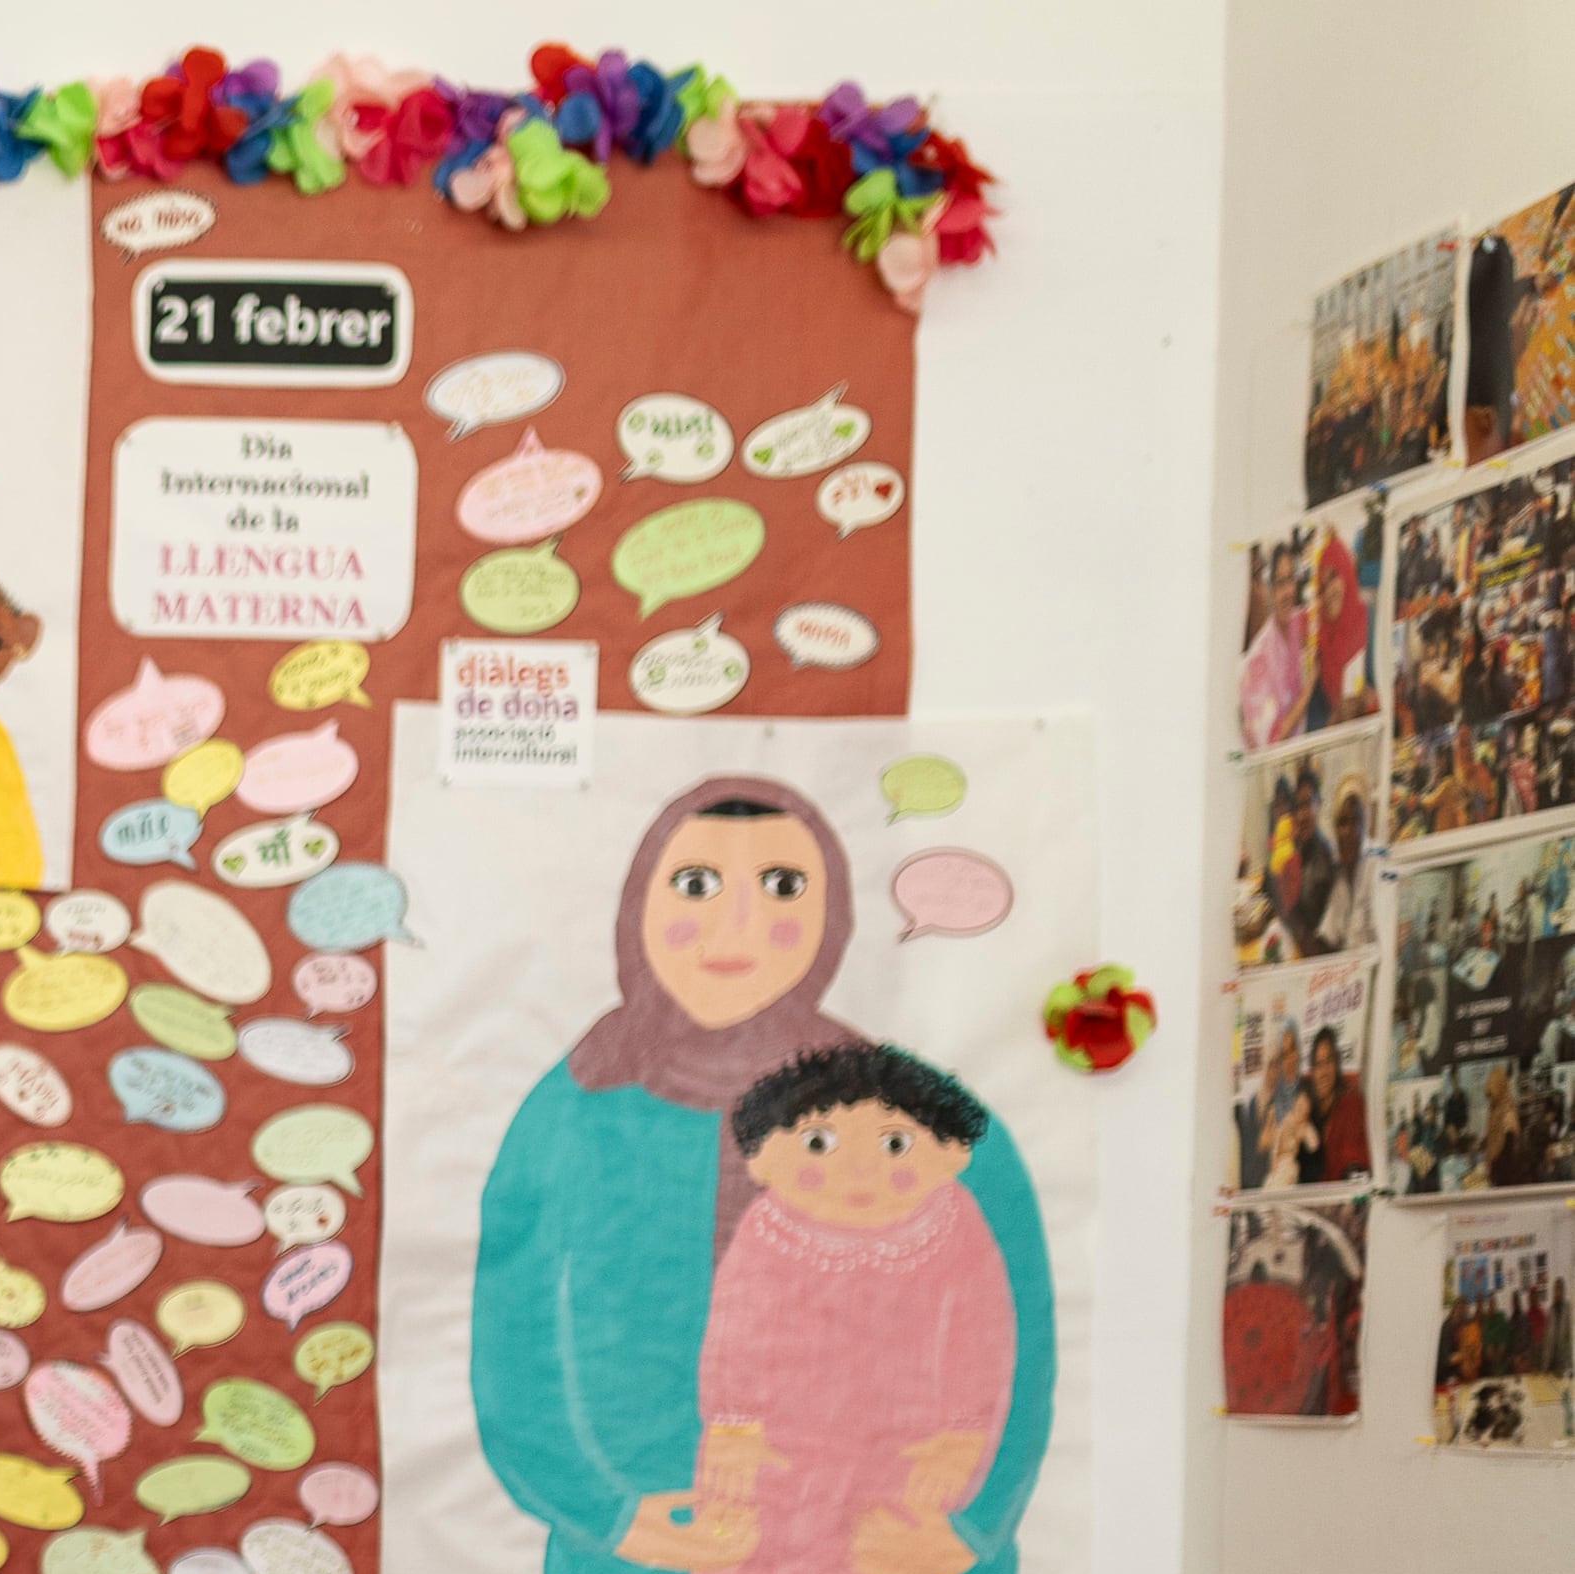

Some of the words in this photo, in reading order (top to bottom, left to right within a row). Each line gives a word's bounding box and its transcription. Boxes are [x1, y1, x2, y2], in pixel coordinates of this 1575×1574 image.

[155, 294, 215, 344] 21
[232, 294, 391, 347] febrer
[160, 469, 370, 499] Internacional
[227, 504, 263, 532] de
[270, 503, 300, 532] la
[158, 544, 366, 580] LLENGUA
[152, 593, 366, 628] MATERNA
[455, 654, 571, 698] diàlegs
[455, 690, 493, 719] de
[503, 690, 579, 721] dona
[454, 743, 578, 766] intercultural
